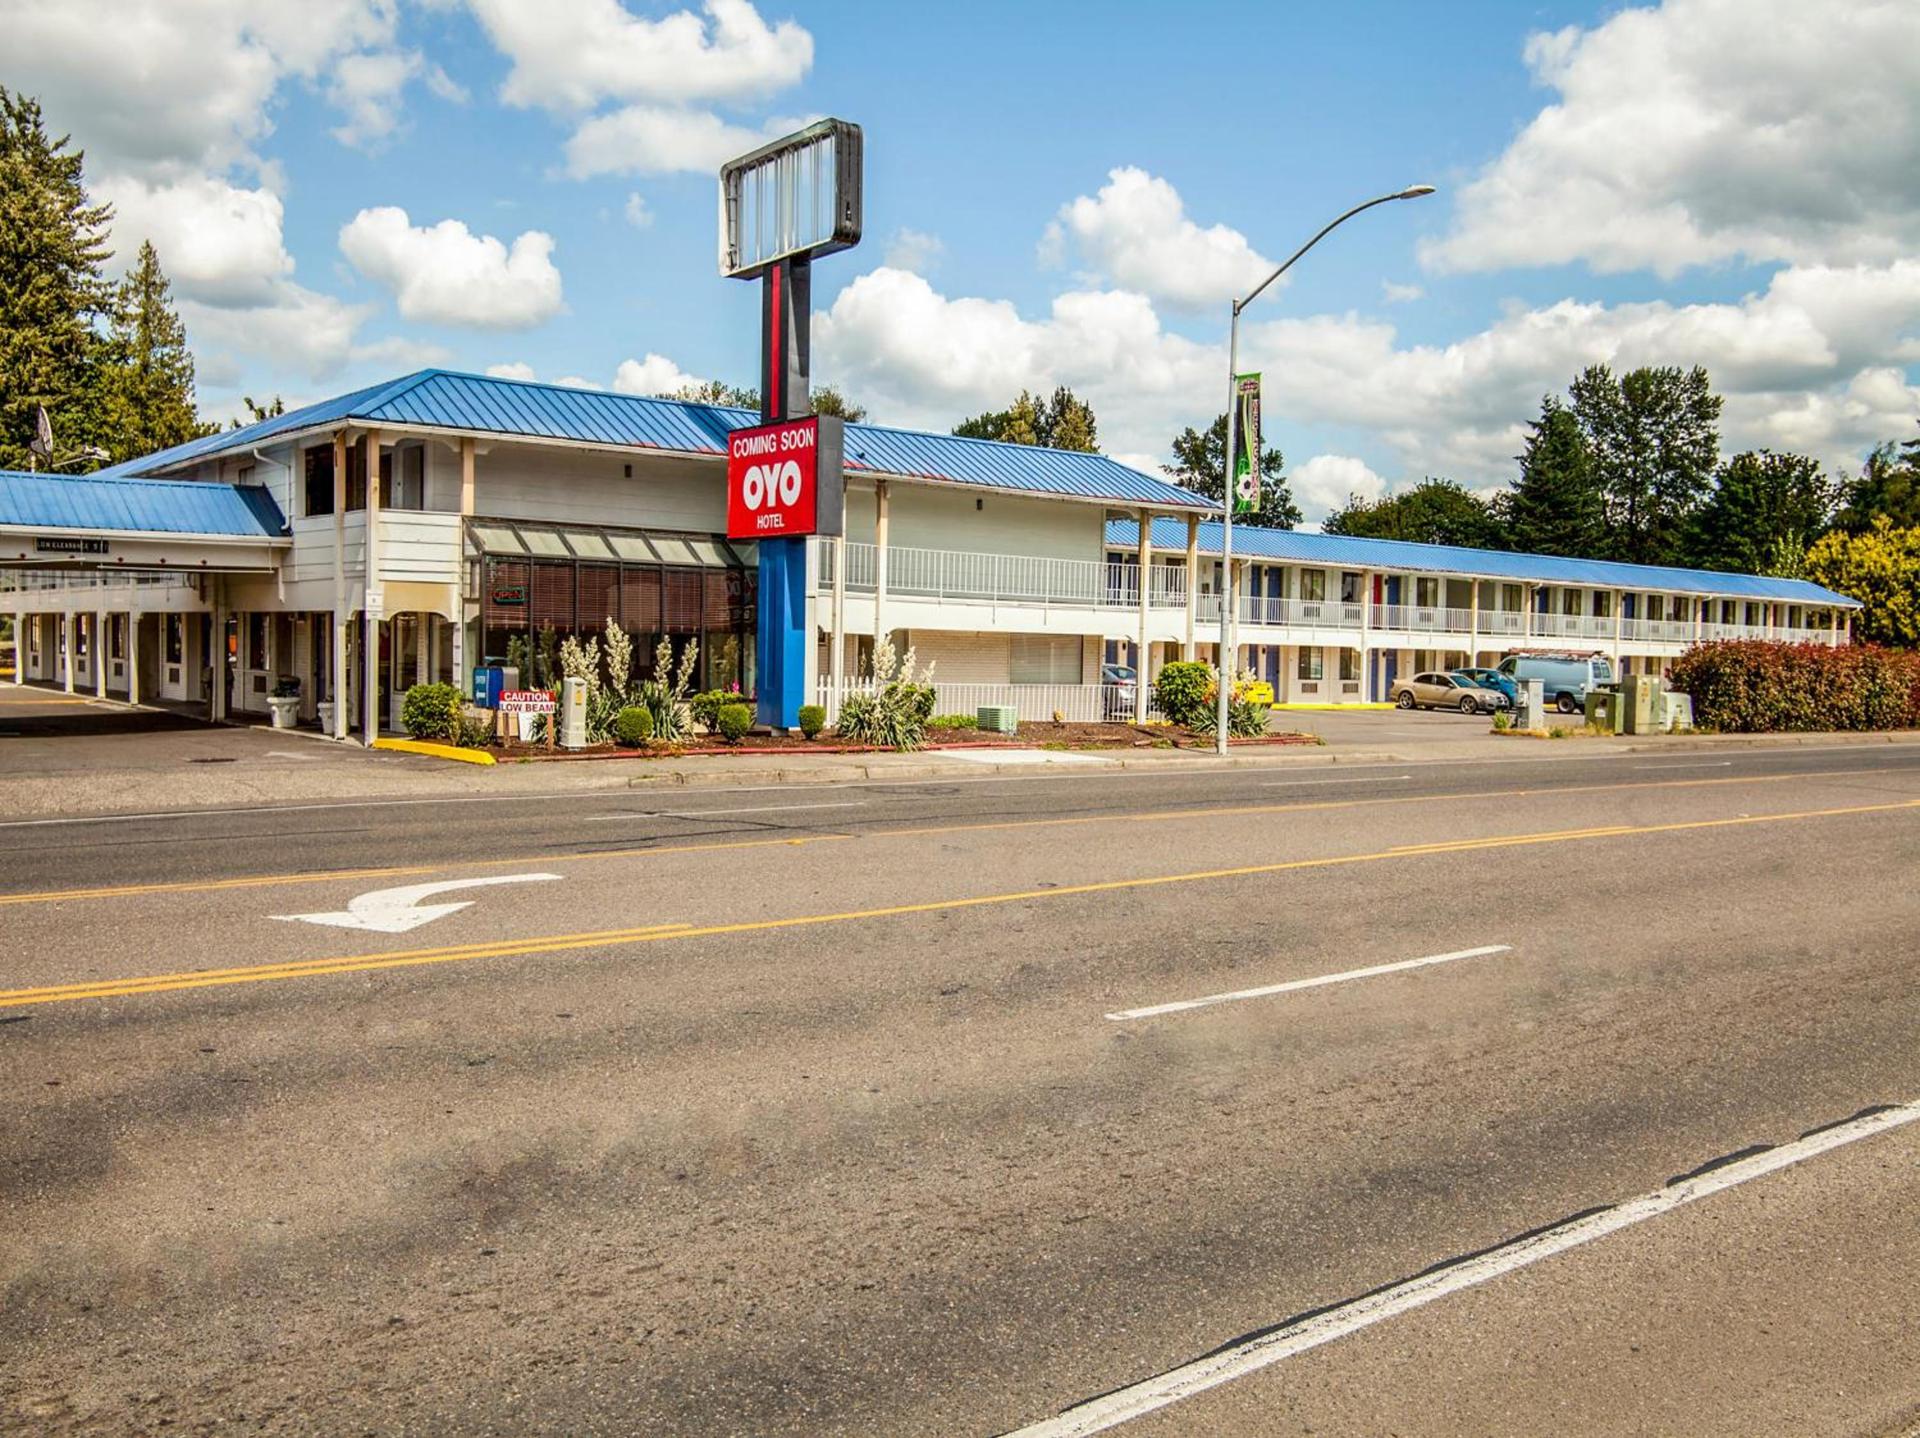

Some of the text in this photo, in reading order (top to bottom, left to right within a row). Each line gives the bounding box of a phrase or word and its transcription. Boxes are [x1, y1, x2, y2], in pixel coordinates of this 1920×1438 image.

[733, 428, 814, 458] COMING SOON
[743, 460, 802, 511] OYO
[757, 513, 785, 529] HOTEL
[504, 692, 550, 701] CAUTION
[501, 703, 553, 712] LOW BEAM
